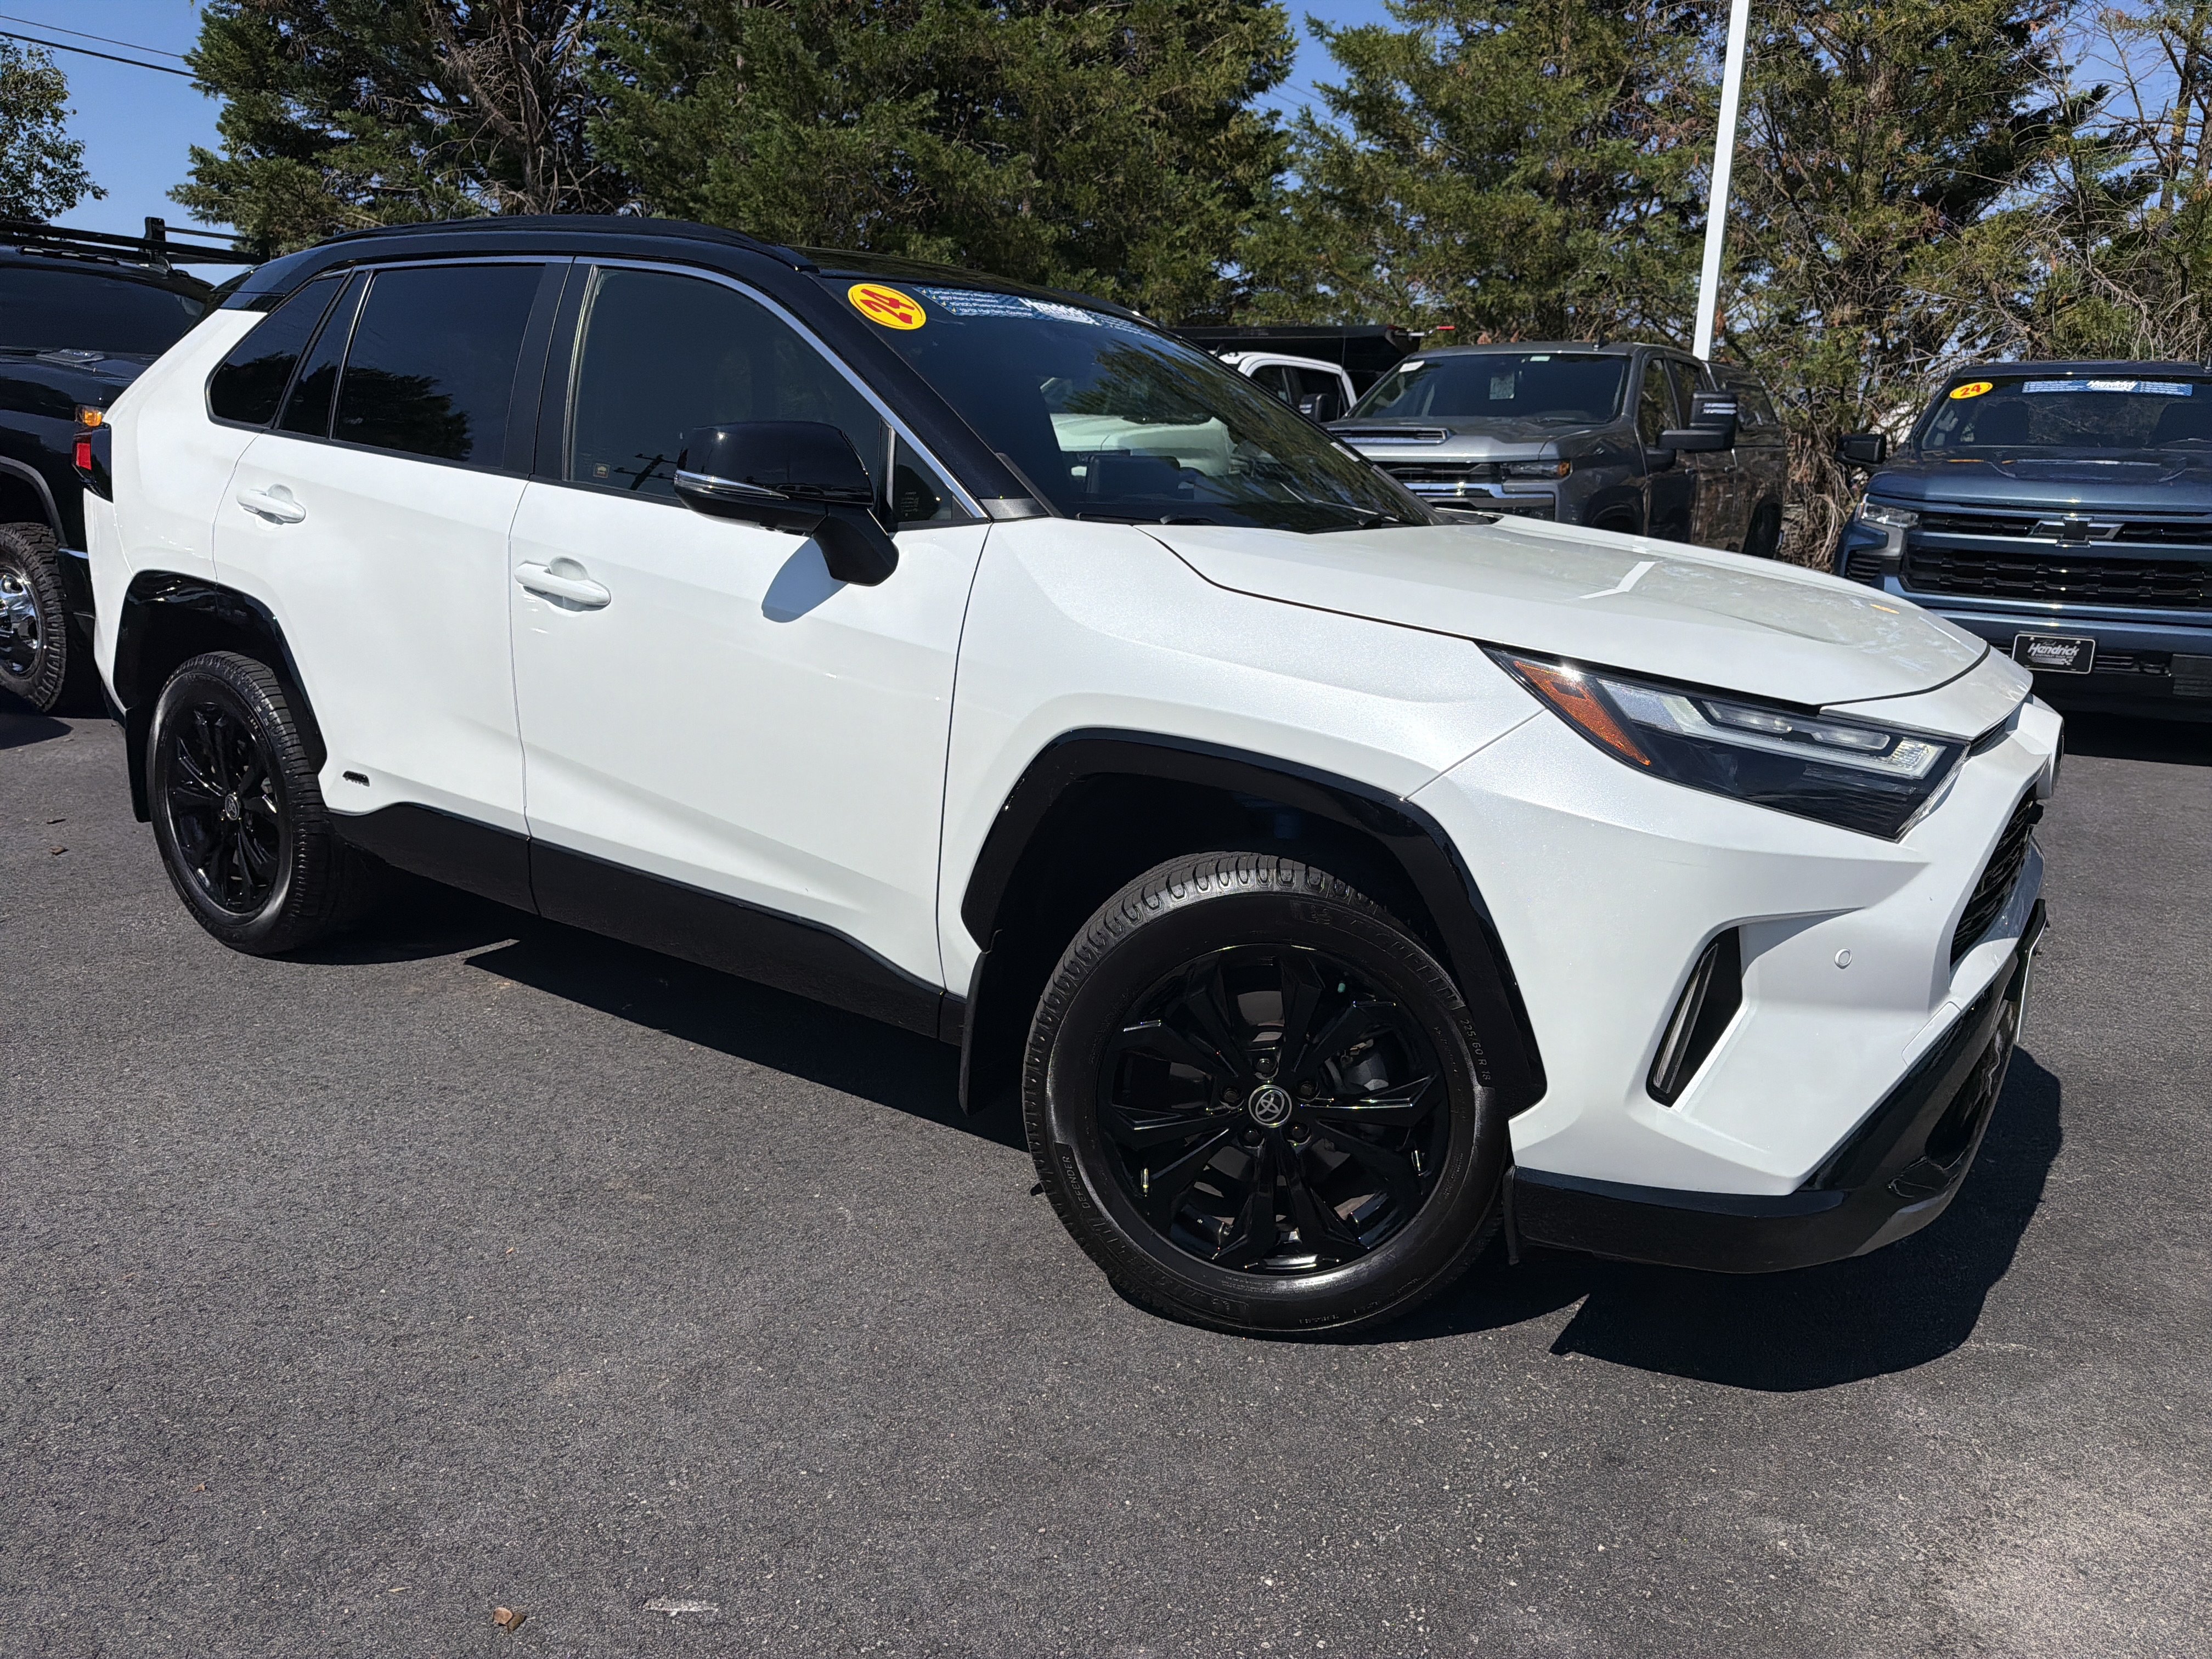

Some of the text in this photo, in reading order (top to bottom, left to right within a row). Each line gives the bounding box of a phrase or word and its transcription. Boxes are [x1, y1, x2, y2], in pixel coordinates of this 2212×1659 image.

[860, 288, 915, 325] 24
[1960, 384, 1982, 397] 24
[2028, 642, 2080, 656] Hendrick
[1460, 1019, 1483, 1055] 225/60
[1481, 1070, 1491, 1080] 18
[1062, 1156, 1091, 1209] DEFENDER
